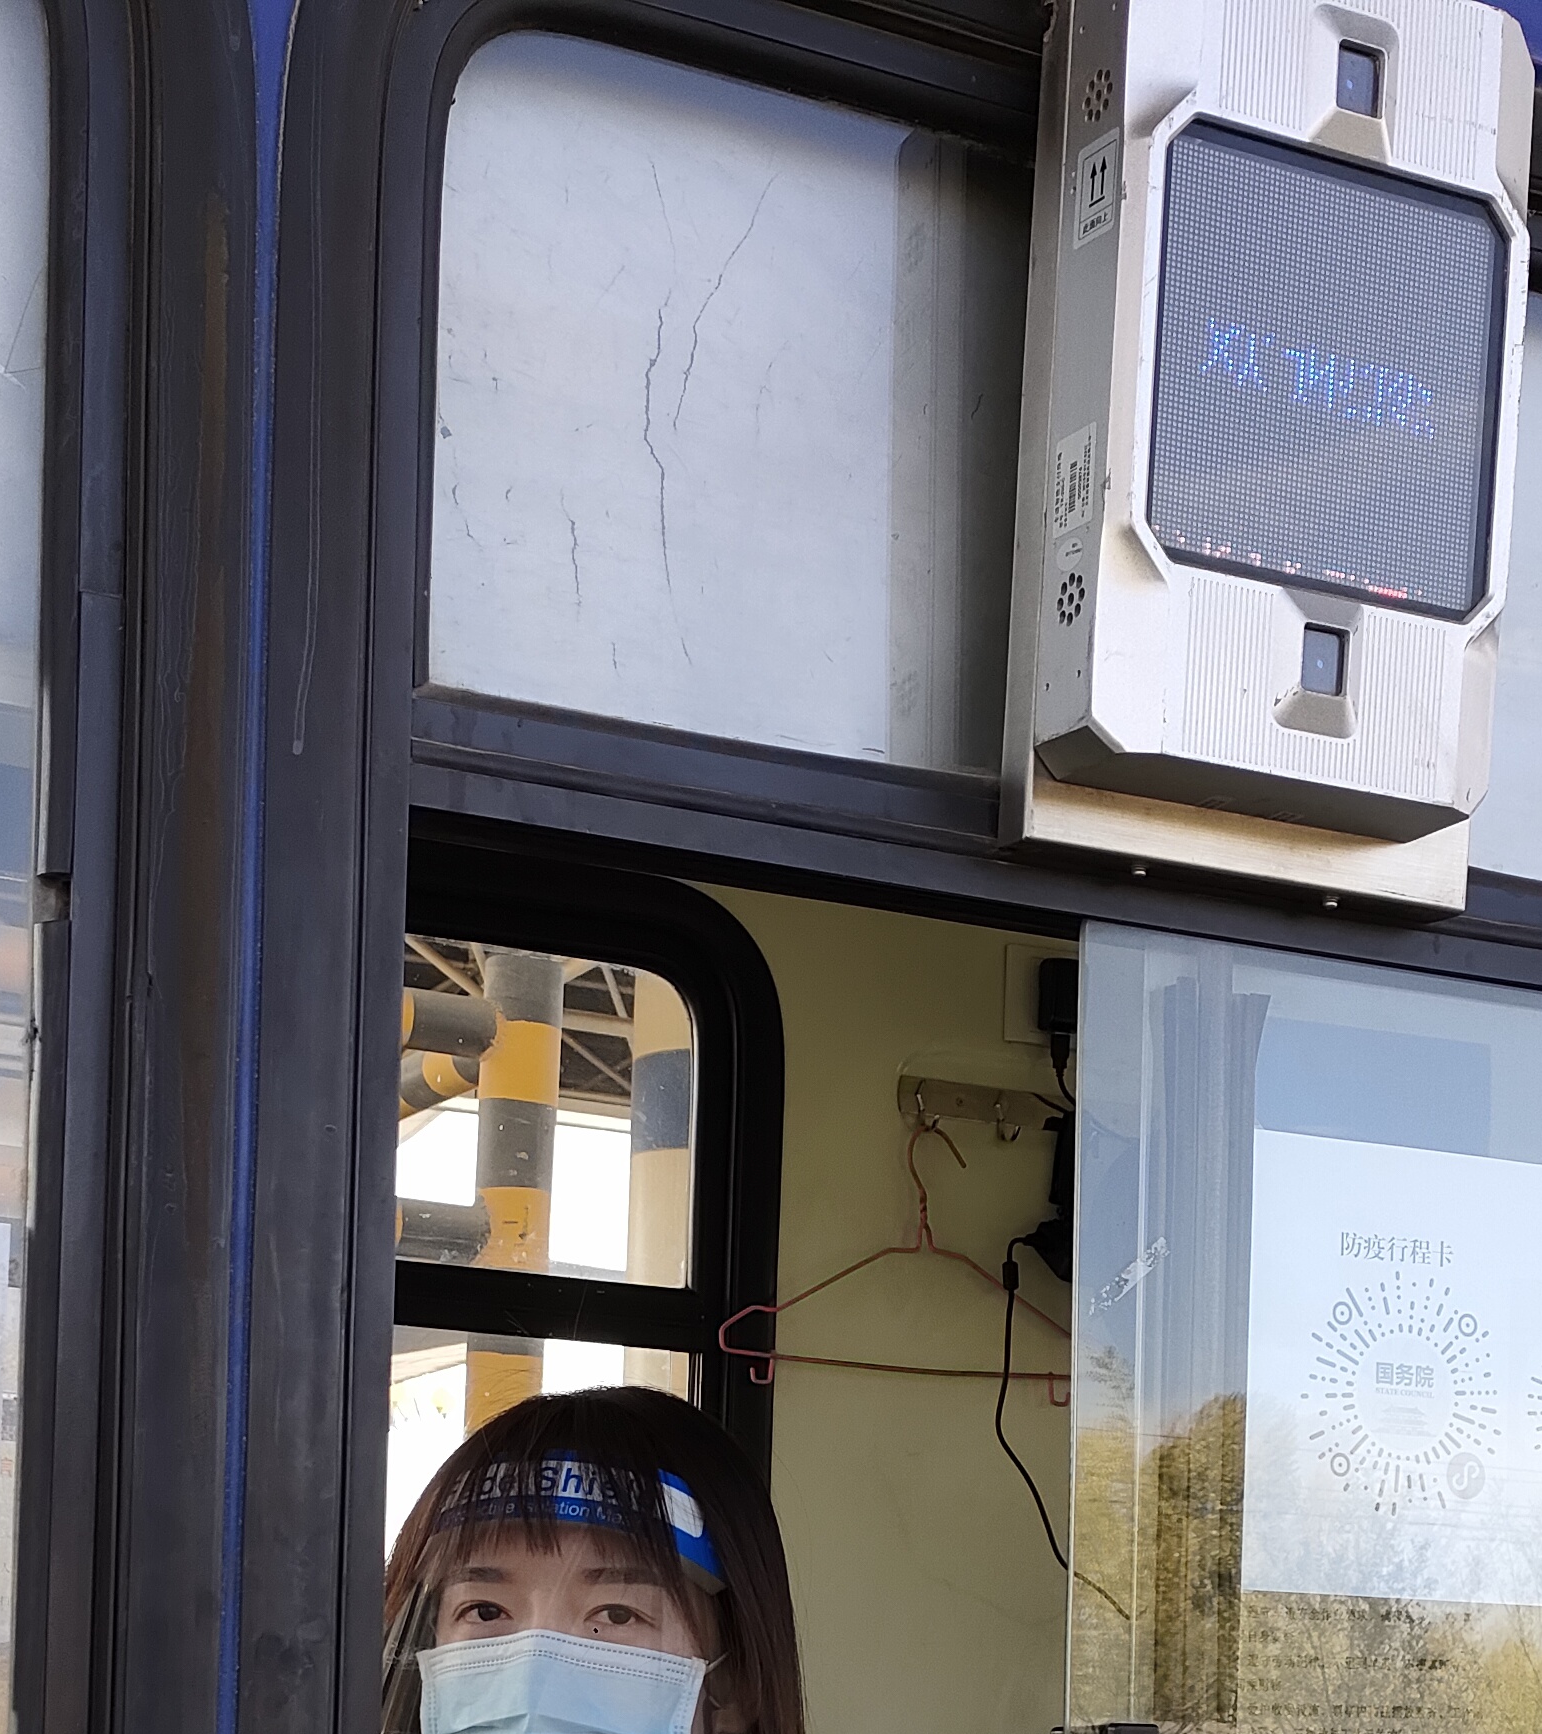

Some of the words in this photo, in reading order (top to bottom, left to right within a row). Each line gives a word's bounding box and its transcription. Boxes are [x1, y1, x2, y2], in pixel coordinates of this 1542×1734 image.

[1339, 1230, 1455, 1268] 防疫行程卡
[1374, 1361, 1436, 1388] 国务院
[1374, 1386, 1401, 1397] STATE
[1402, 1388, 1436, 1399] COUNCIL
